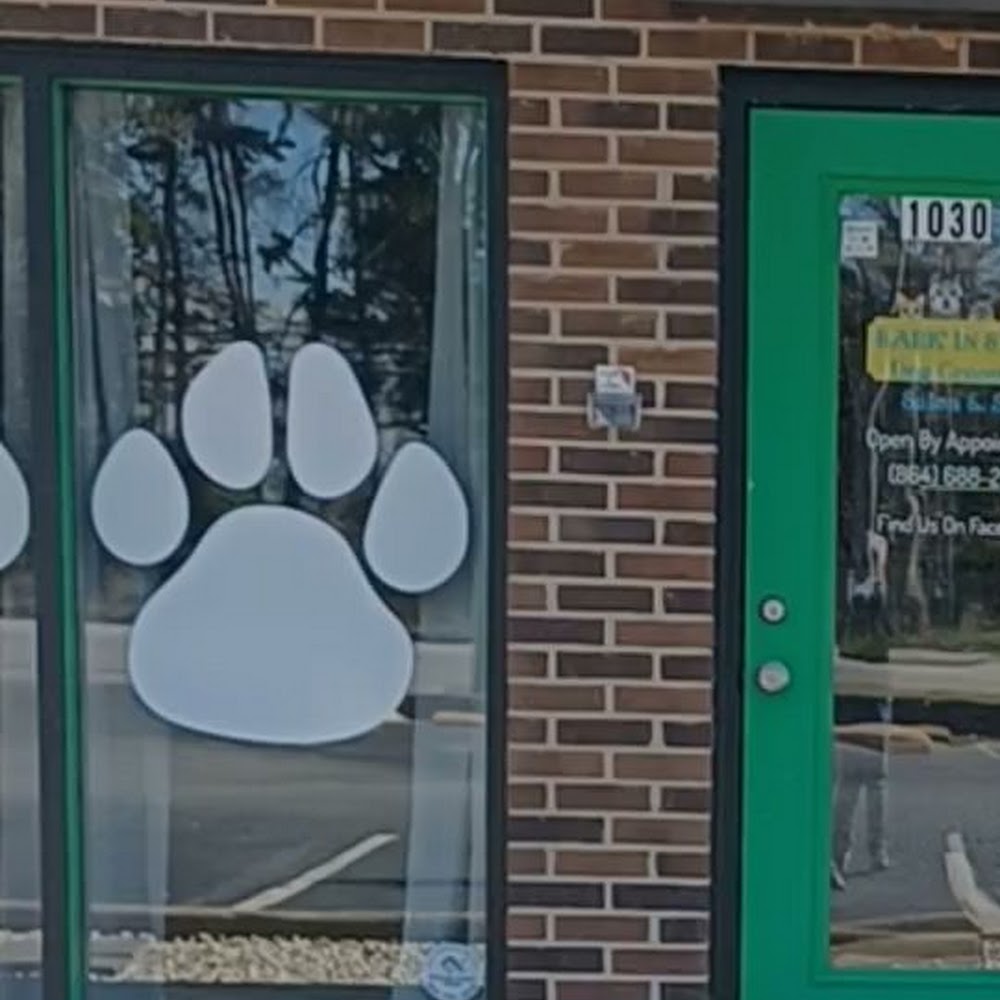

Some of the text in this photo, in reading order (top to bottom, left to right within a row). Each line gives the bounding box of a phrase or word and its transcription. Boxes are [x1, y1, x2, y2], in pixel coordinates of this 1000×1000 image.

[909, 200, 987, 239] 1030
[866, 427, 914, 452] Open
[919, 429, 942, 455] By
[877, 514, 914, 534] Find
[918, 514, 938, 535] Us
[943, 515, 966, 534] On
